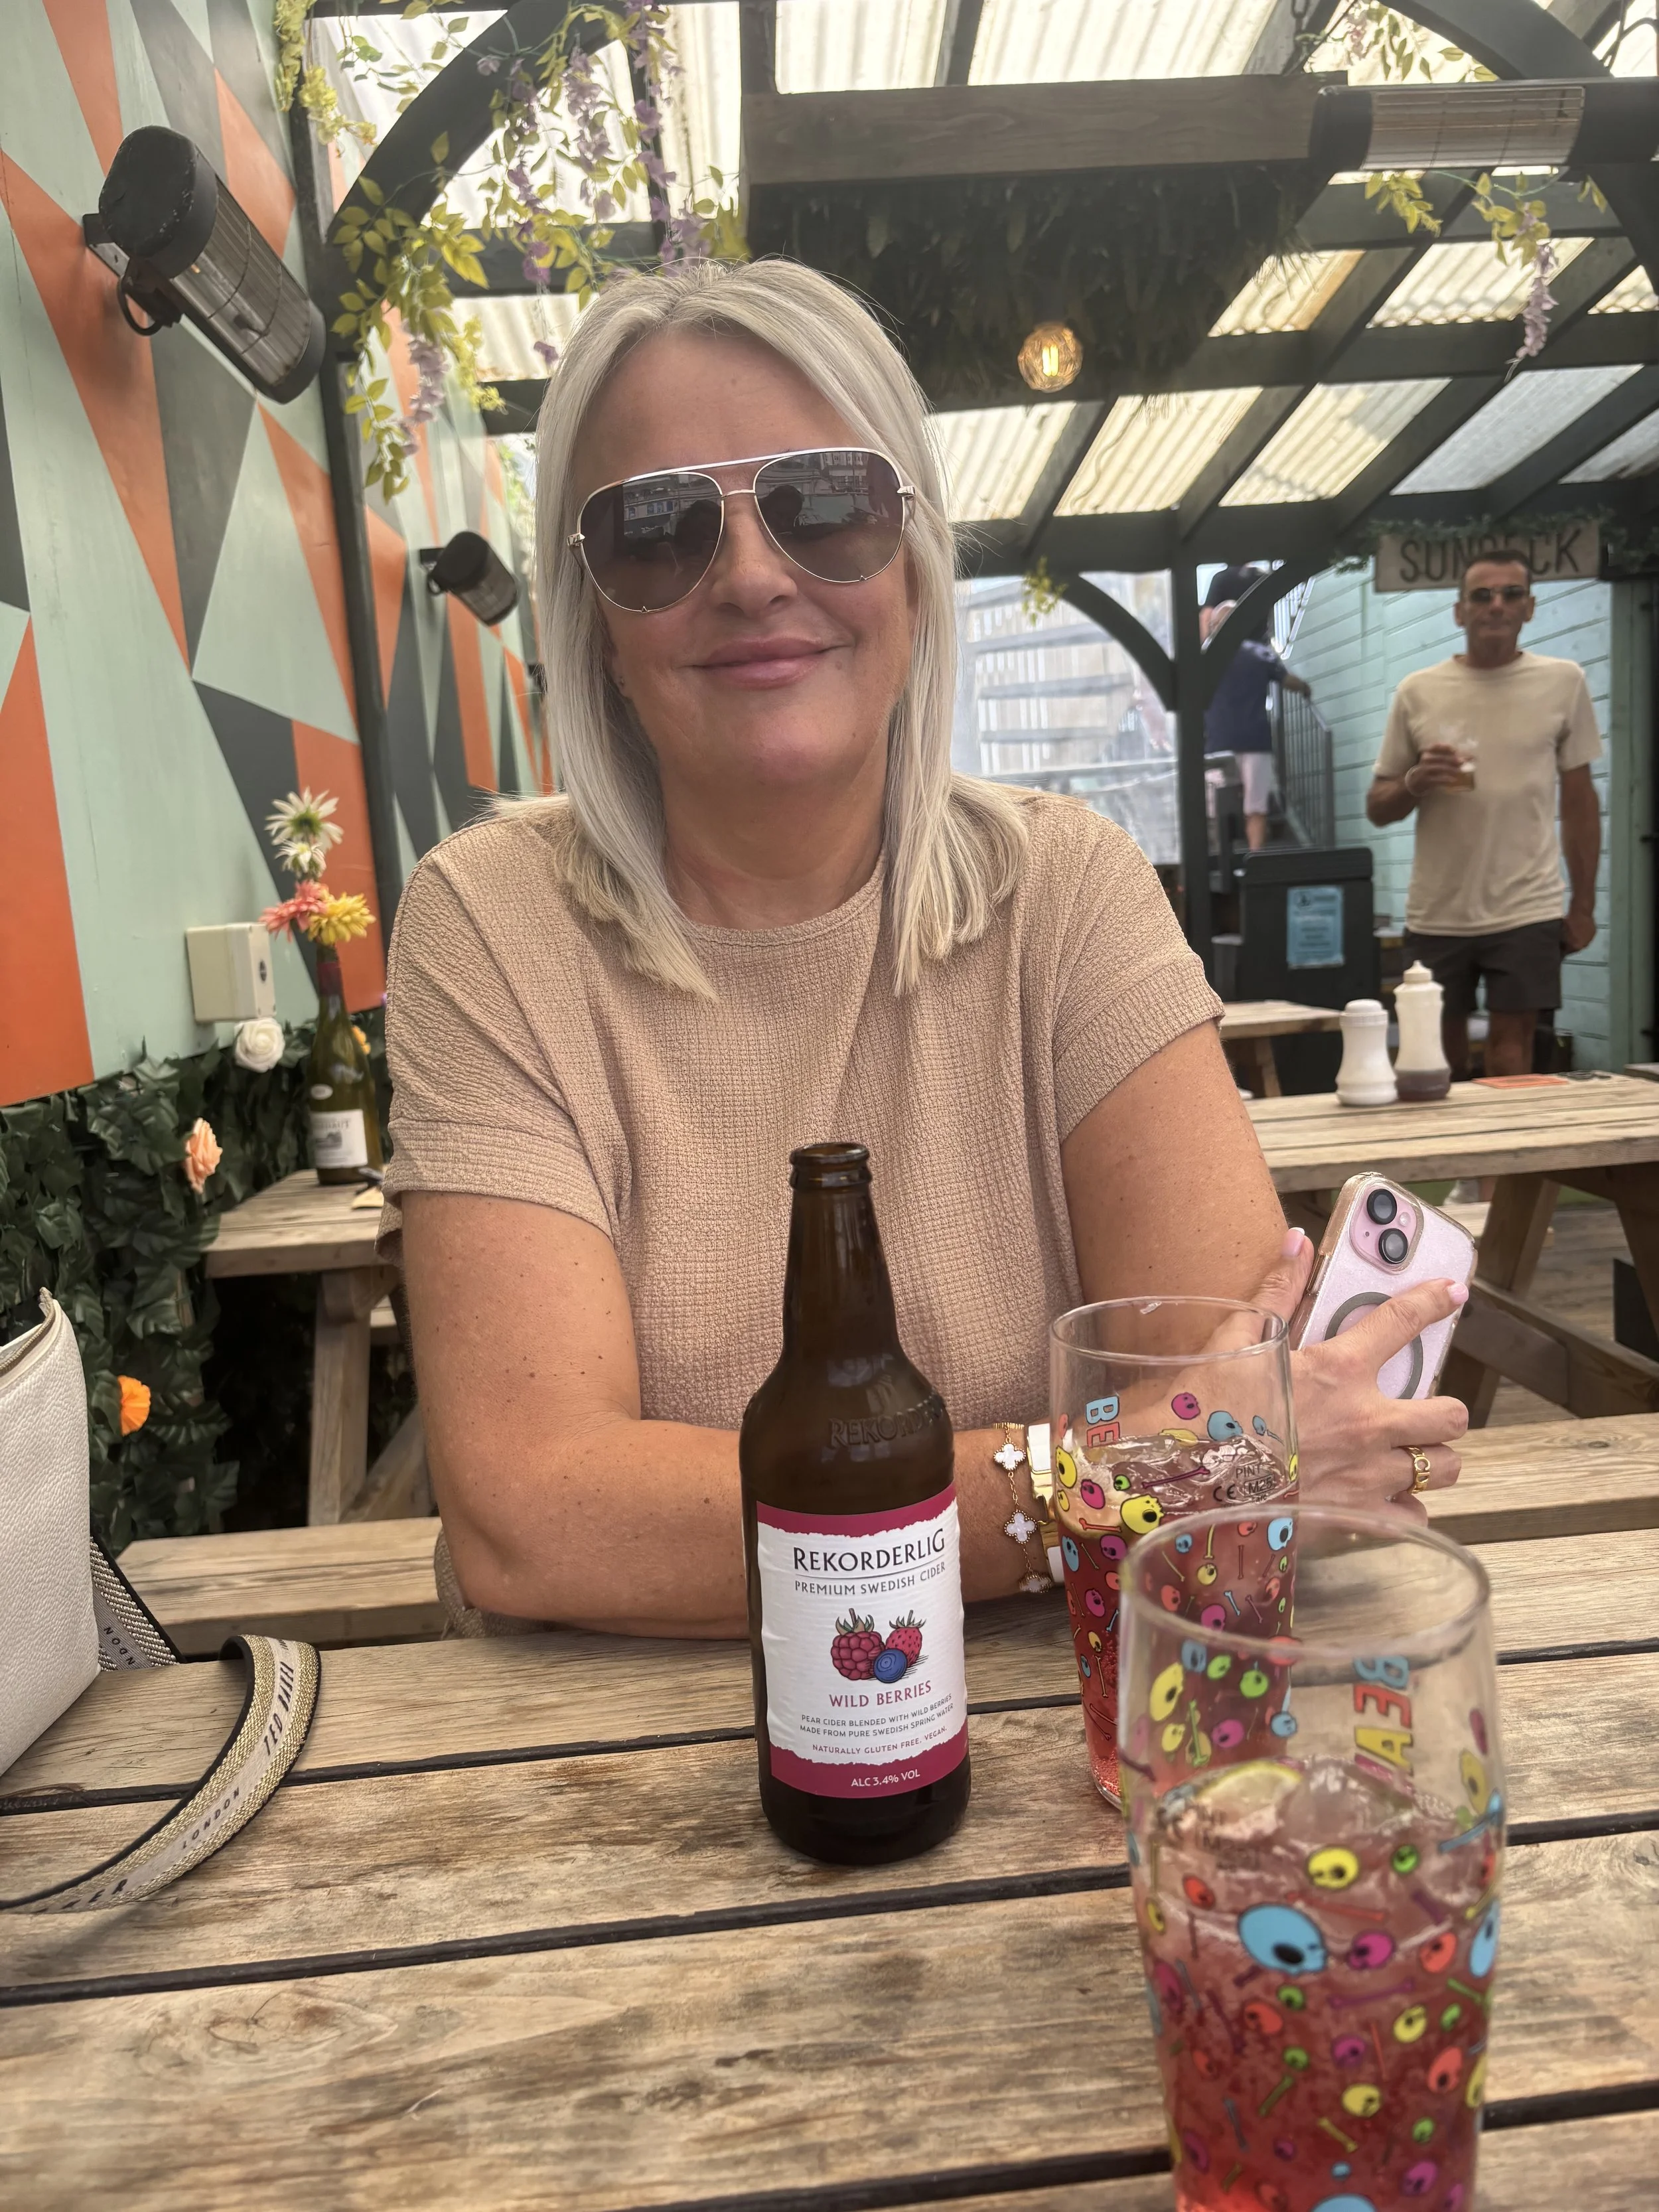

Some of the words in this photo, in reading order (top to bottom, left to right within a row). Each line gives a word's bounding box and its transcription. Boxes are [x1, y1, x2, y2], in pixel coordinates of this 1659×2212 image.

[1400, 528, 1581, 583] SUNCK
[793, 1528, 945, 1572] REKORDERLIG
[795, 1580, 855, 1595] PREMIUM
[861, 1575, 915, 1594] SWEDISH
[920, 1561, 946, 1581] CIDER
[802, 1714, 821, 1724] PEAR
[823, 1718, 846, 1727] CIDER
[849, 1718, 886, 1727] BLENDED
[889, 1713, 909, 1723] WITH
[910, 1706, 928, 1718] WILD
[930, 1693, 952, 1711] BERRIES
[829, 1694, 869, 1708] WILD
[877, 1680, 932, 1706] BERRIES
[800, 1725, 821, 1735] MADE
[823, 1729, 846, 1737] FROM
[873, 1724, 908, 1736] SWEDISH
[910, 1714, 936, 1729] SPRING
[936, 1703, 954, 1718] WATER
[812, 1744, 861, 1754] NATURALLY
[864, 1743, 898, 1754] GLUTEN
[901, 1737, 922, 1749] FREE.
[924, 1726, 947, 1740] VEGAN.
[851, 1777, 871, 1787] ALC
[873, 1775, 899, 1786] 3.4%
[901, 1769, 920, 1781] VOL
[182, 1787, 239, 1849] LONDON
